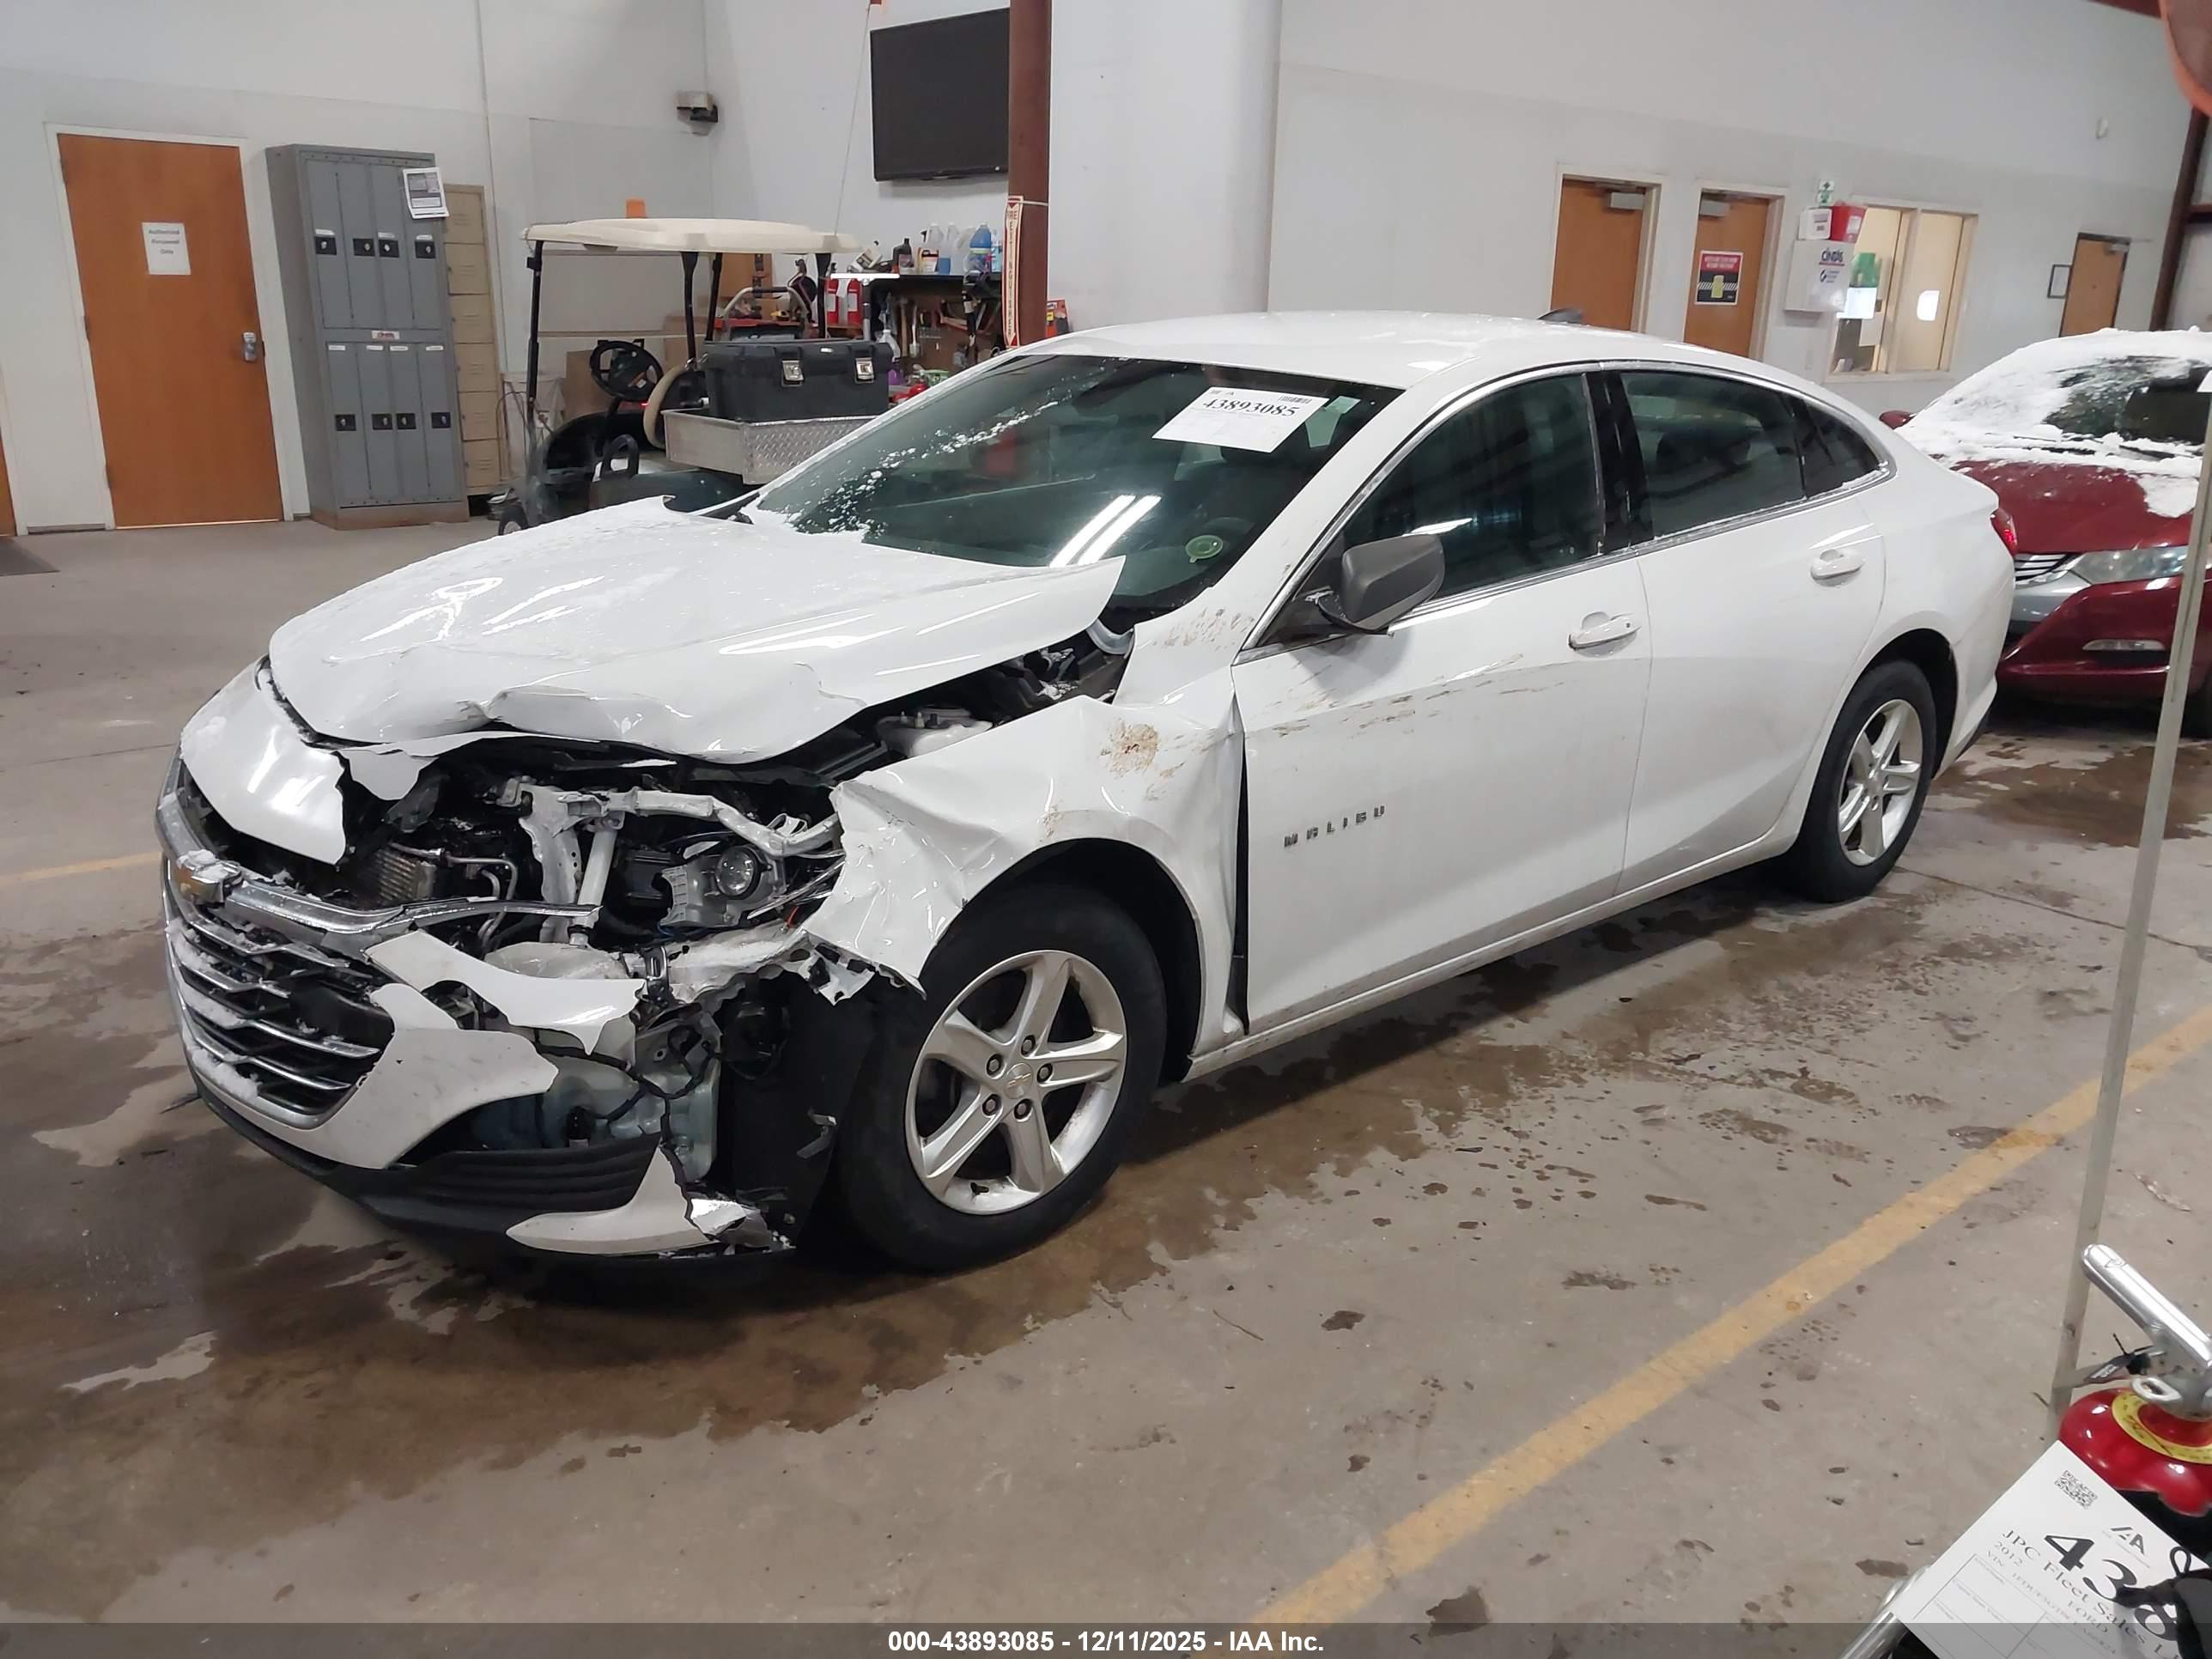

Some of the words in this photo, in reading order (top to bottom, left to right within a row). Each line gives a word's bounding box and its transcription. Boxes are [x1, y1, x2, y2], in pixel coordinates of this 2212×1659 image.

[1203, 398, 1301, 416] 43893085
[1284, 805, 1385, 848] MALIBU
[1994, 1540, 2023, 1567] 2012
[2002, 1529, 2041, 1560] JPC
[2043, 1561, 2089, 1603] Fleet
[2095, 1601, 2146, 1644] Sales
